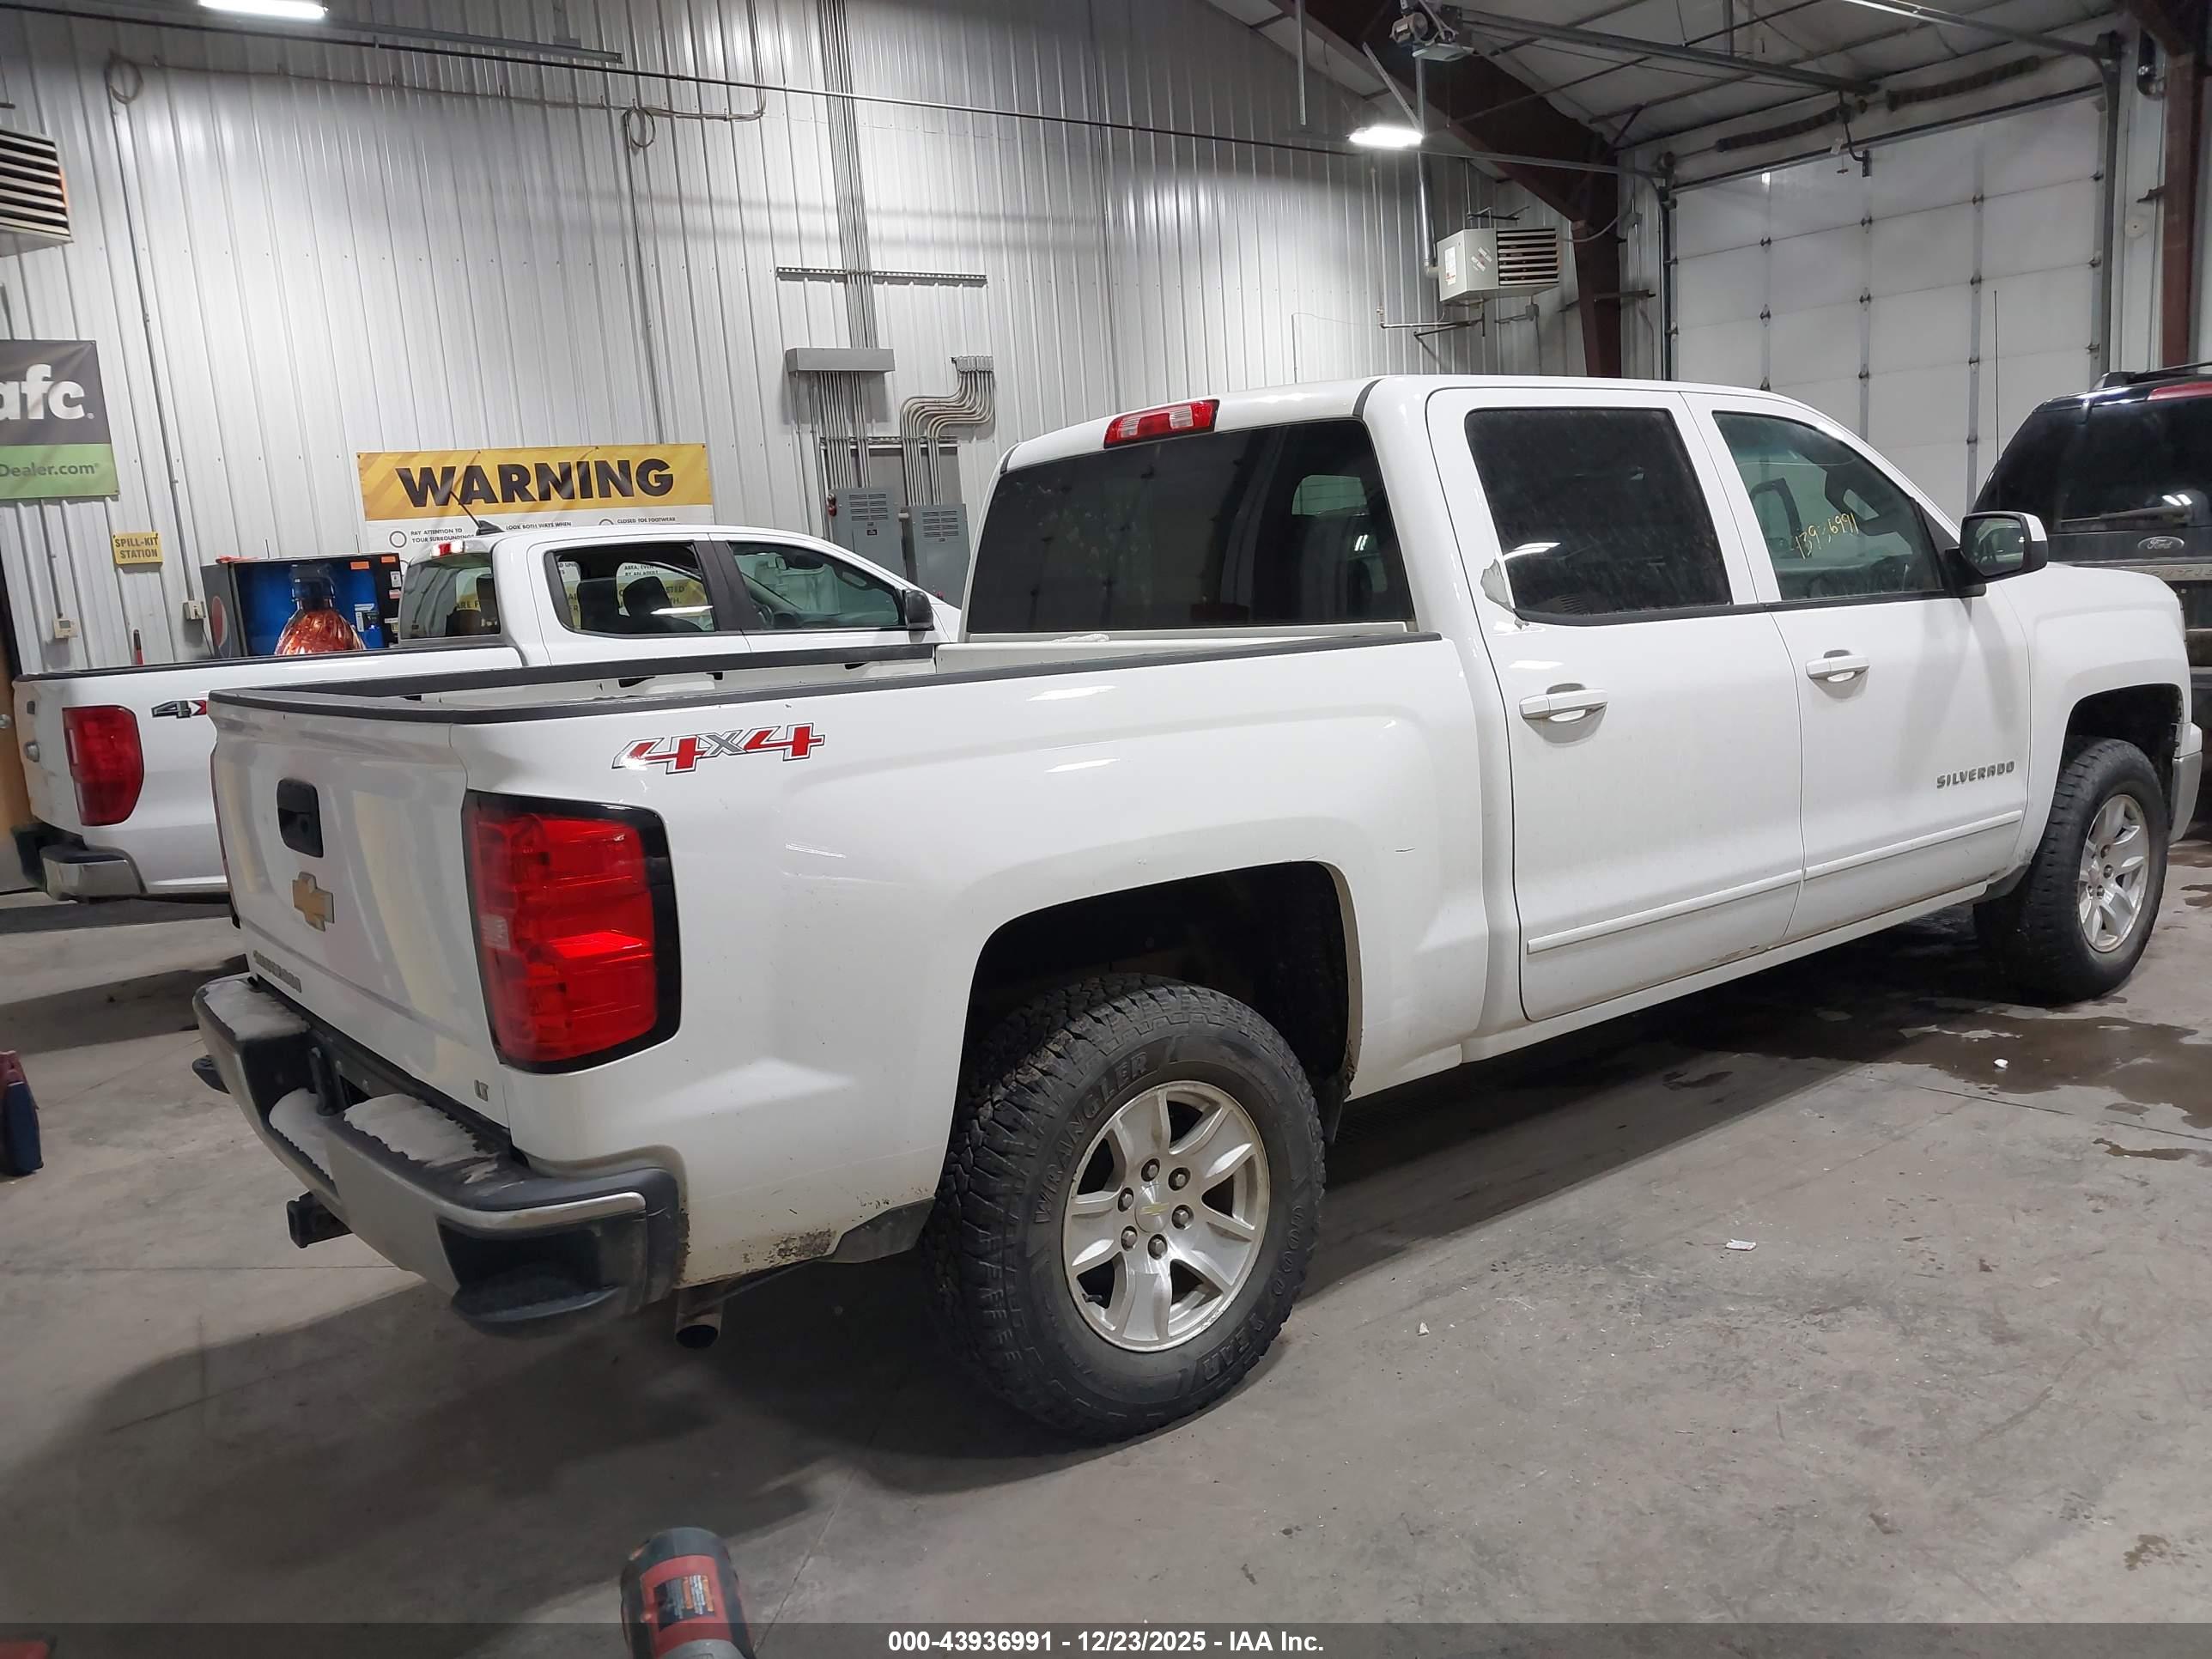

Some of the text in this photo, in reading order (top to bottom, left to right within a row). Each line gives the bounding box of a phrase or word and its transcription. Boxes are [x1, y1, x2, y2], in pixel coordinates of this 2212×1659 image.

[395, 458, 674, 507] WARNING
[114, 537, 158, 548] SPILL-KIT
[120, 549, 158, 559] STATION
[1936, 761, 2014, 789] SILVERADO
[473, 1079, 489, 1102] LT
[1034, 1051, 1148, 1225] WRANGLER
